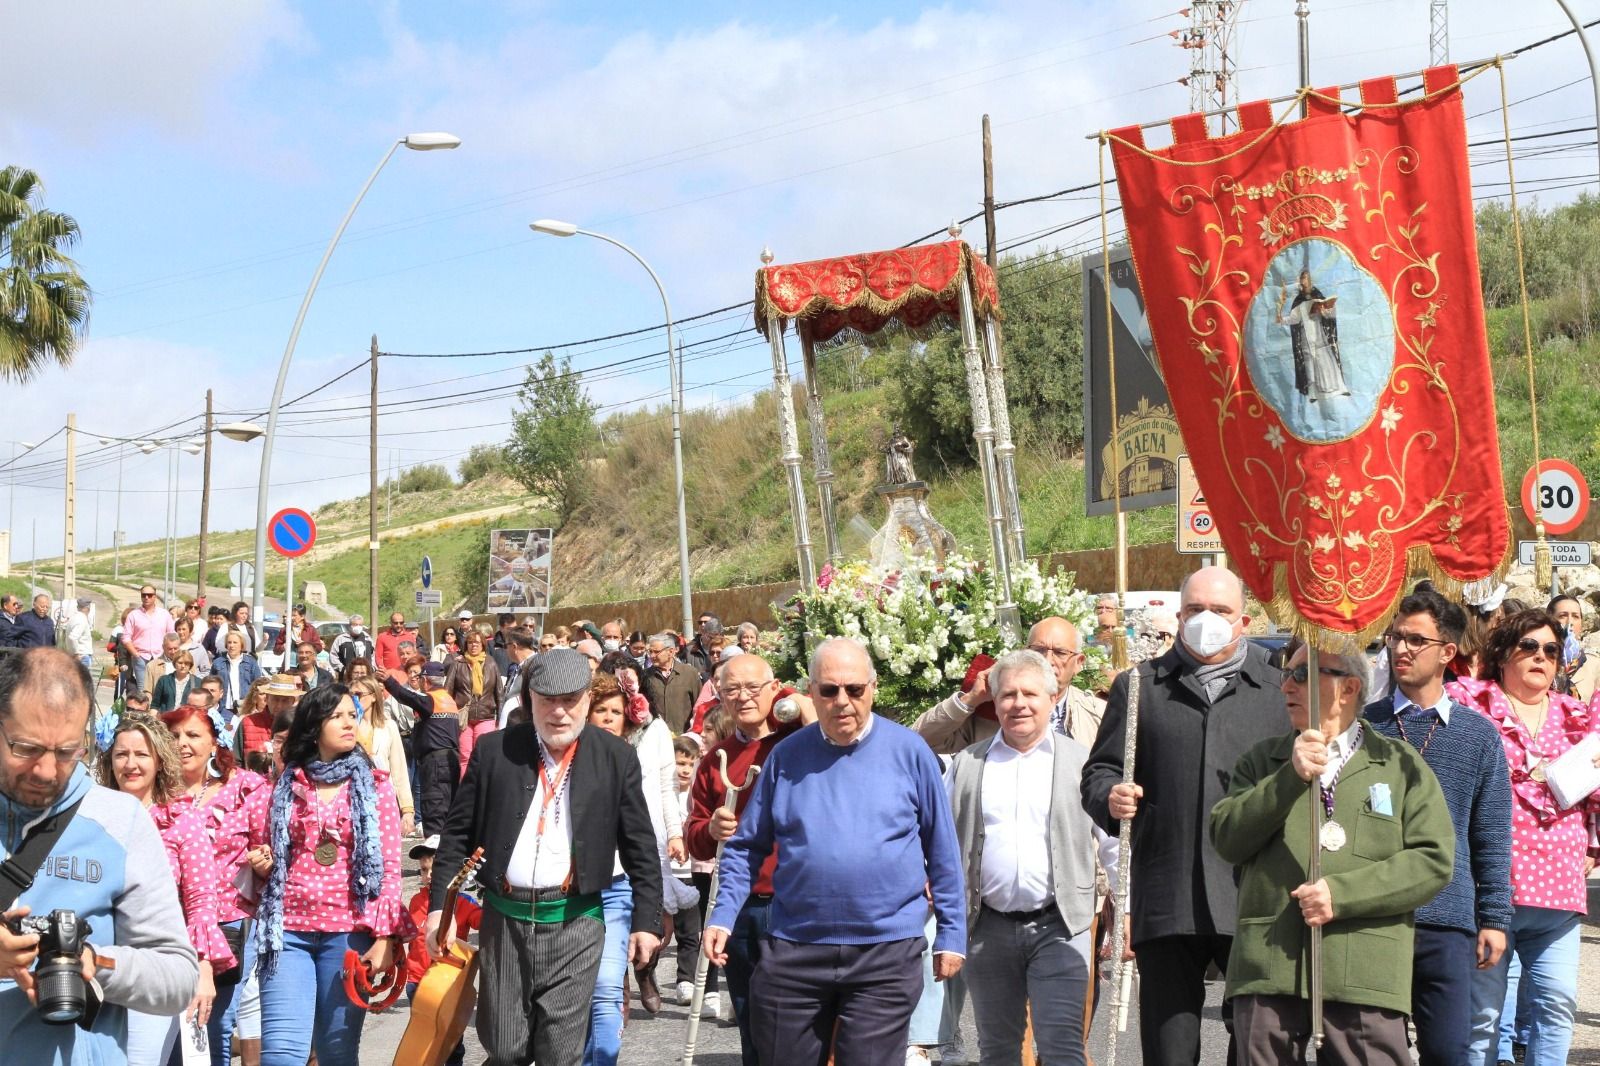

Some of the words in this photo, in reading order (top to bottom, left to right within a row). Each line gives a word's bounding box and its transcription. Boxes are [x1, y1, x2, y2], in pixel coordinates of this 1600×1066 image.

[1111, 421, 1151, 450] Dnominación
[1151, 419, 1160, 429] de
[1161, 420, 1179, 436] origen
[1124, 432, 1166, 461] BAENA
[1540, 485, 1574, 509] 30
[1195, 517, 1210, 527] 20
[1550, 554, 1582, 562] IUDAD
[1551, 545, 1577, 553] TODA
[34, 856, 103, 884] IELD
